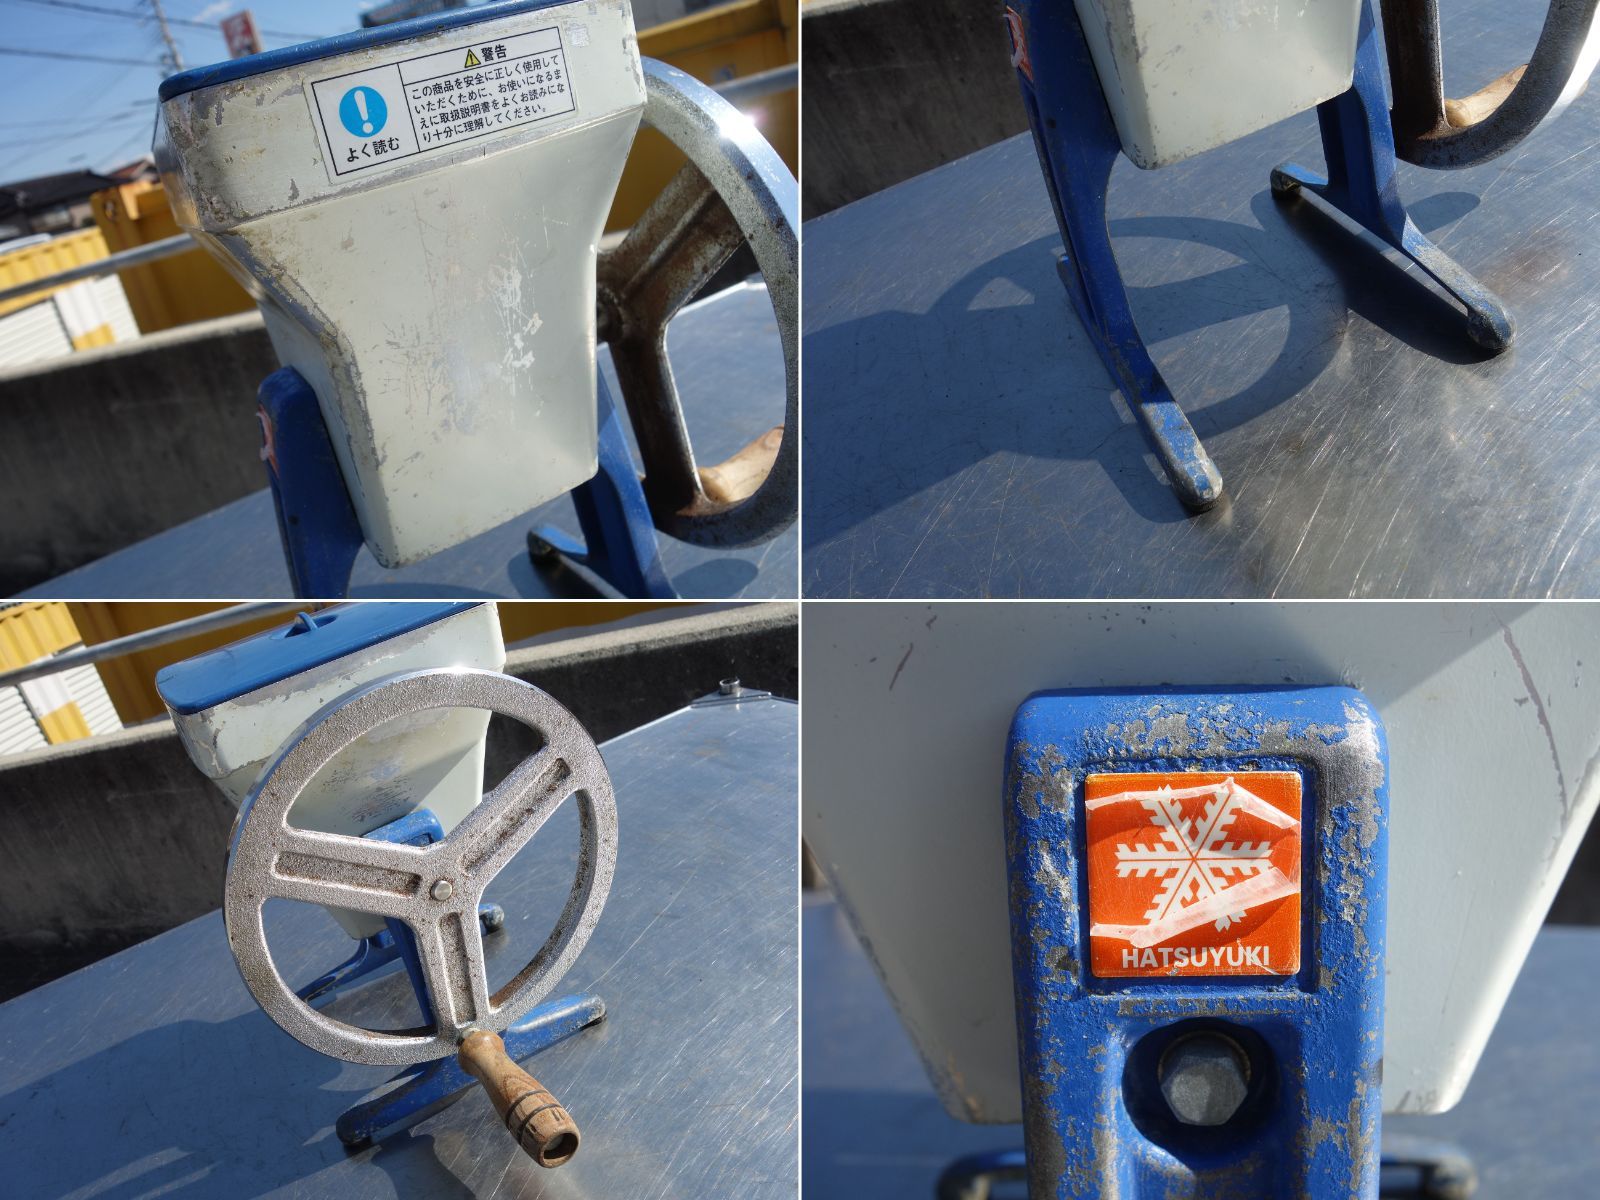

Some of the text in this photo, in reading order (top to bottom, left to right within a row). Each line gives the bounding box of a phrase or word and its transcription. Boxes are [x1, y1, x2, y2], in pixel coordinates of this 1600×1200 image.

[481, 44, 507, 62] 警告
[412, 55, 559, 100] この商品を安全に正しく使用して
[414, 68, 562, 114] いただくために、お使いになるま
[420, 83, 565, 129] えに取扱説明書をよくお読みにな
[424, 103, 547, 143] り十分に理解してください。
[346, 137, 400, 163] よく読む
[1122, 946, 1270, 968] HATSUYUKI
